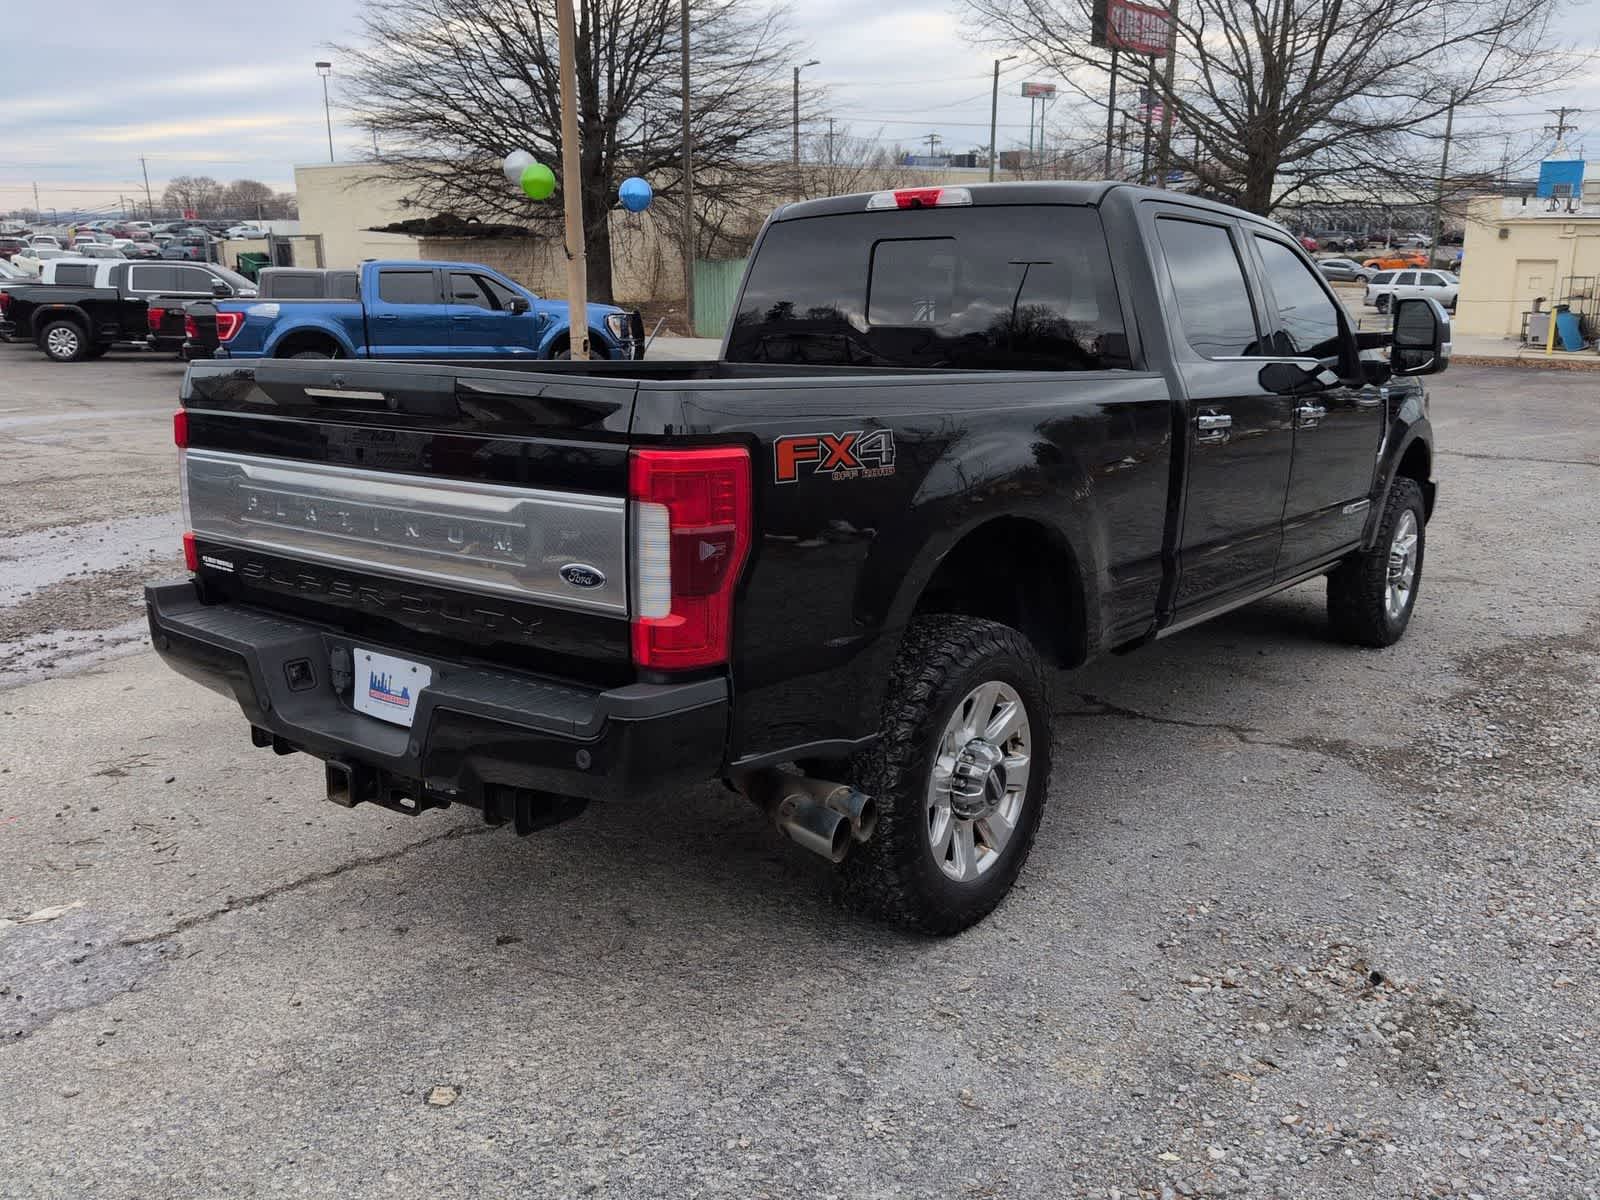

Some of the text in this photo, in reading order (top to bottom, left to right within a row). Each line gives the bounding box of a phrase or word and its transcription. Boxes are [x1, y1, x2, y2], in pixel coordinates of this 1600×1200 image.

[774, 429, 896, 484] FX4
[831, 466, 896, 481] OFF ROAD
[247, 496, 513, 552] PLATINUM
[241, 562, 545, 640] SUPER DUTY
[567, 568, 595, 586] Ford
